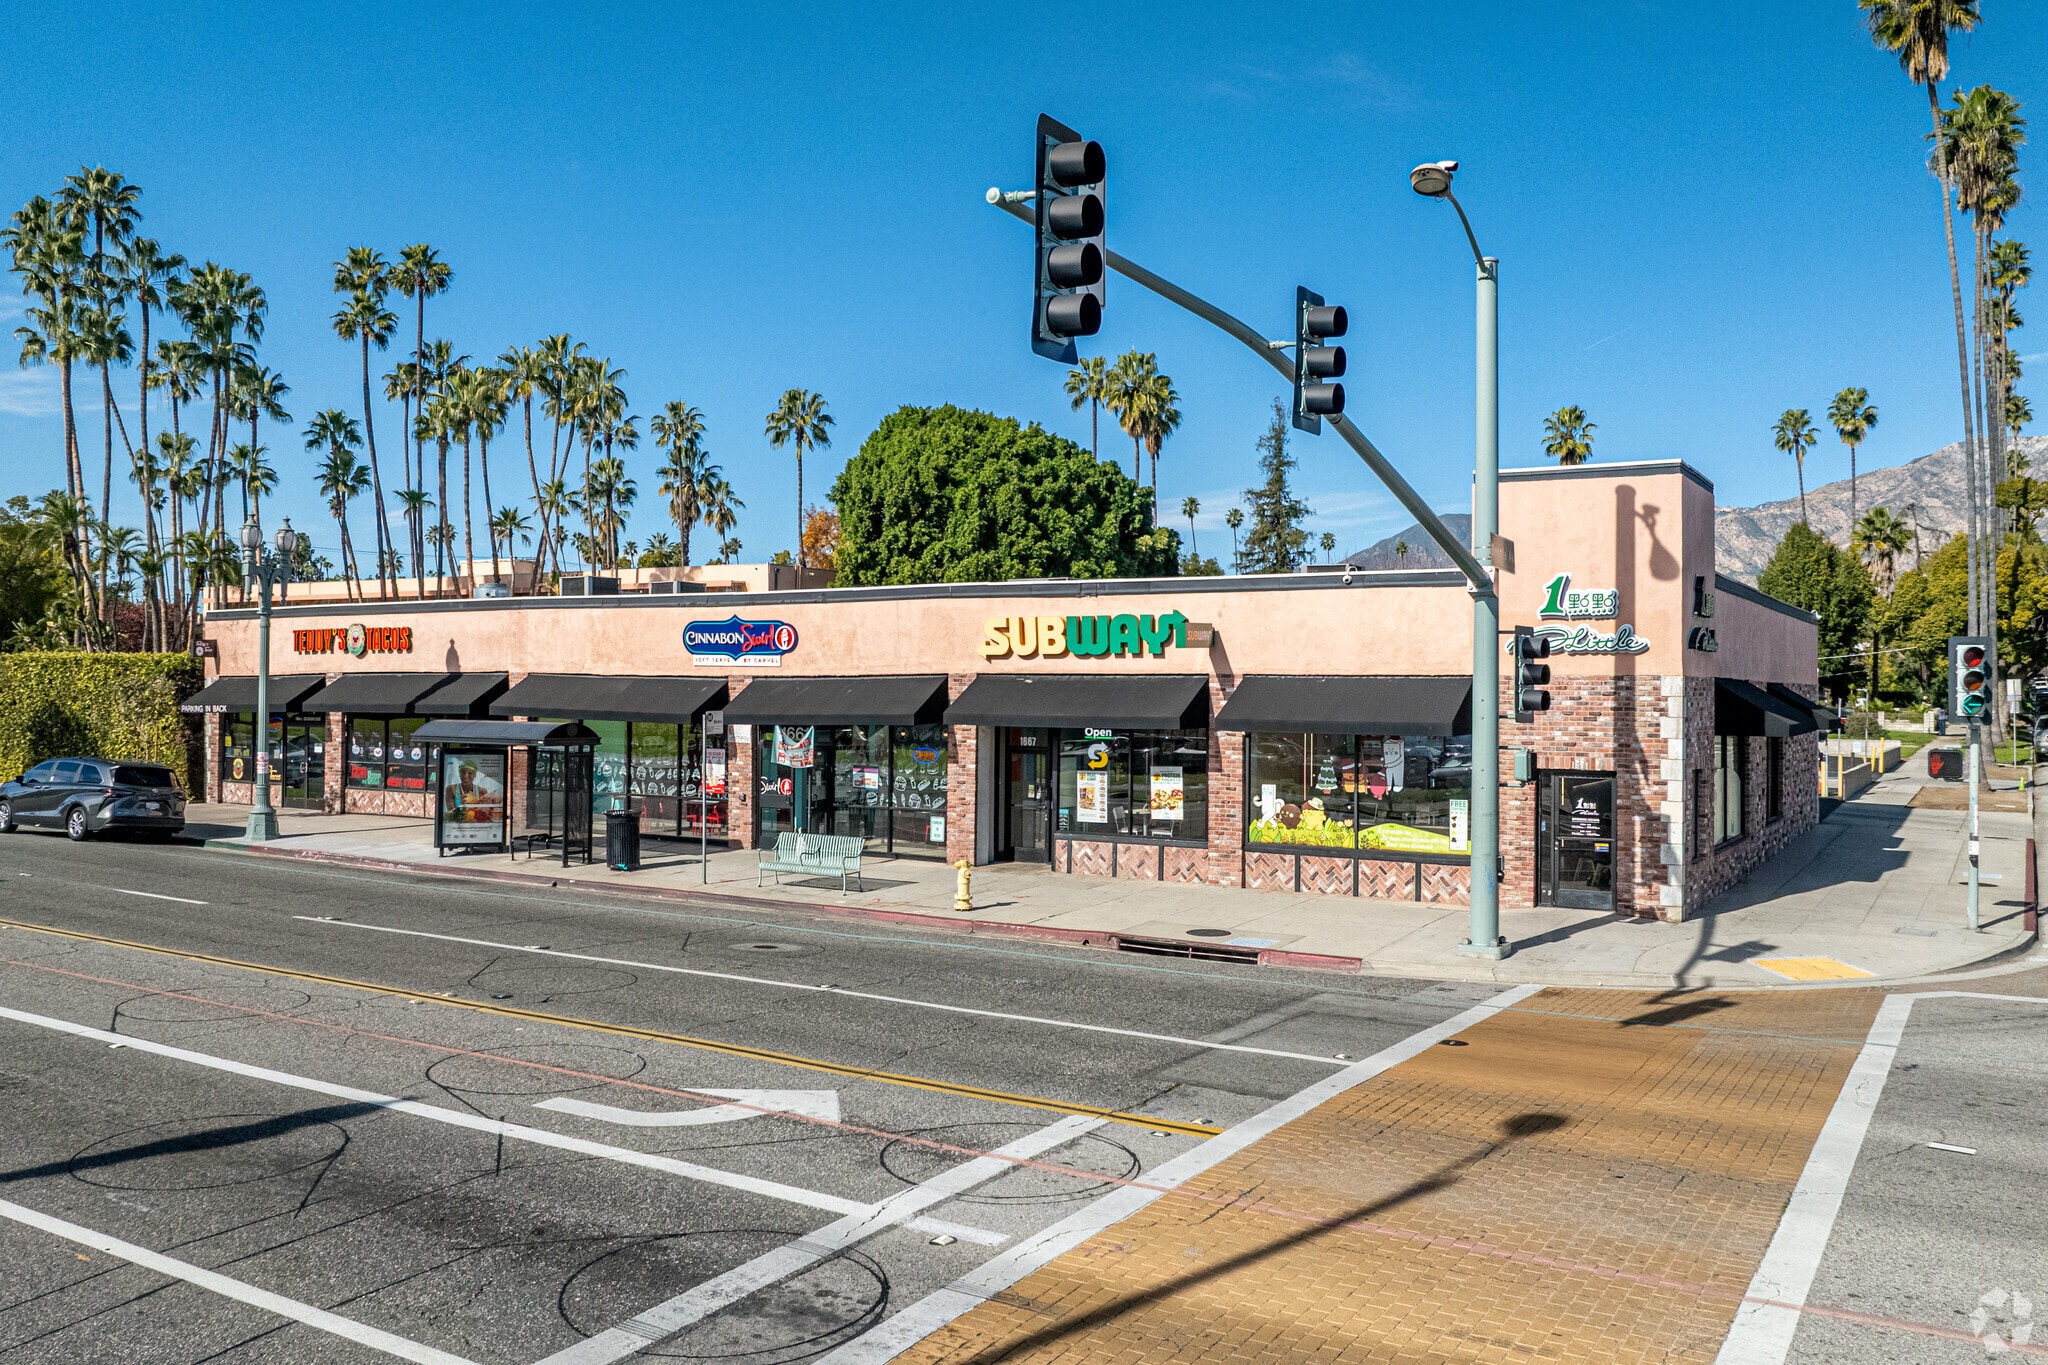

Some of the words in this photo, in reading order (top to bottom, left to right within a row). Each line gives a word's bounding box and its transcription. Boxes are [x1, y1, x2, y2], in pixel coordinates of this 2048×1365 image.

[292, 628, 345, 651] TEDDY'S
[366, 627, 409, 650] TACOS
[686, 631, 744, 645] CINNABON
[740, 623, 776, 652] Swirl
[976, 609, 1188, 657] SUBWAY
[1186, 630, 1212, 641] SUBWAY
[181, 704, 203, 713] PARKING
[205, 704, 211, 713] IN
[212, 704, 227, 713] BACK
[1084, 727, 1112, 739] Open
[1020, 736, 1037, 746] 1667
[760, 776, 781, 795] Swirl
[1450, 800, 1467, 808] FREE
